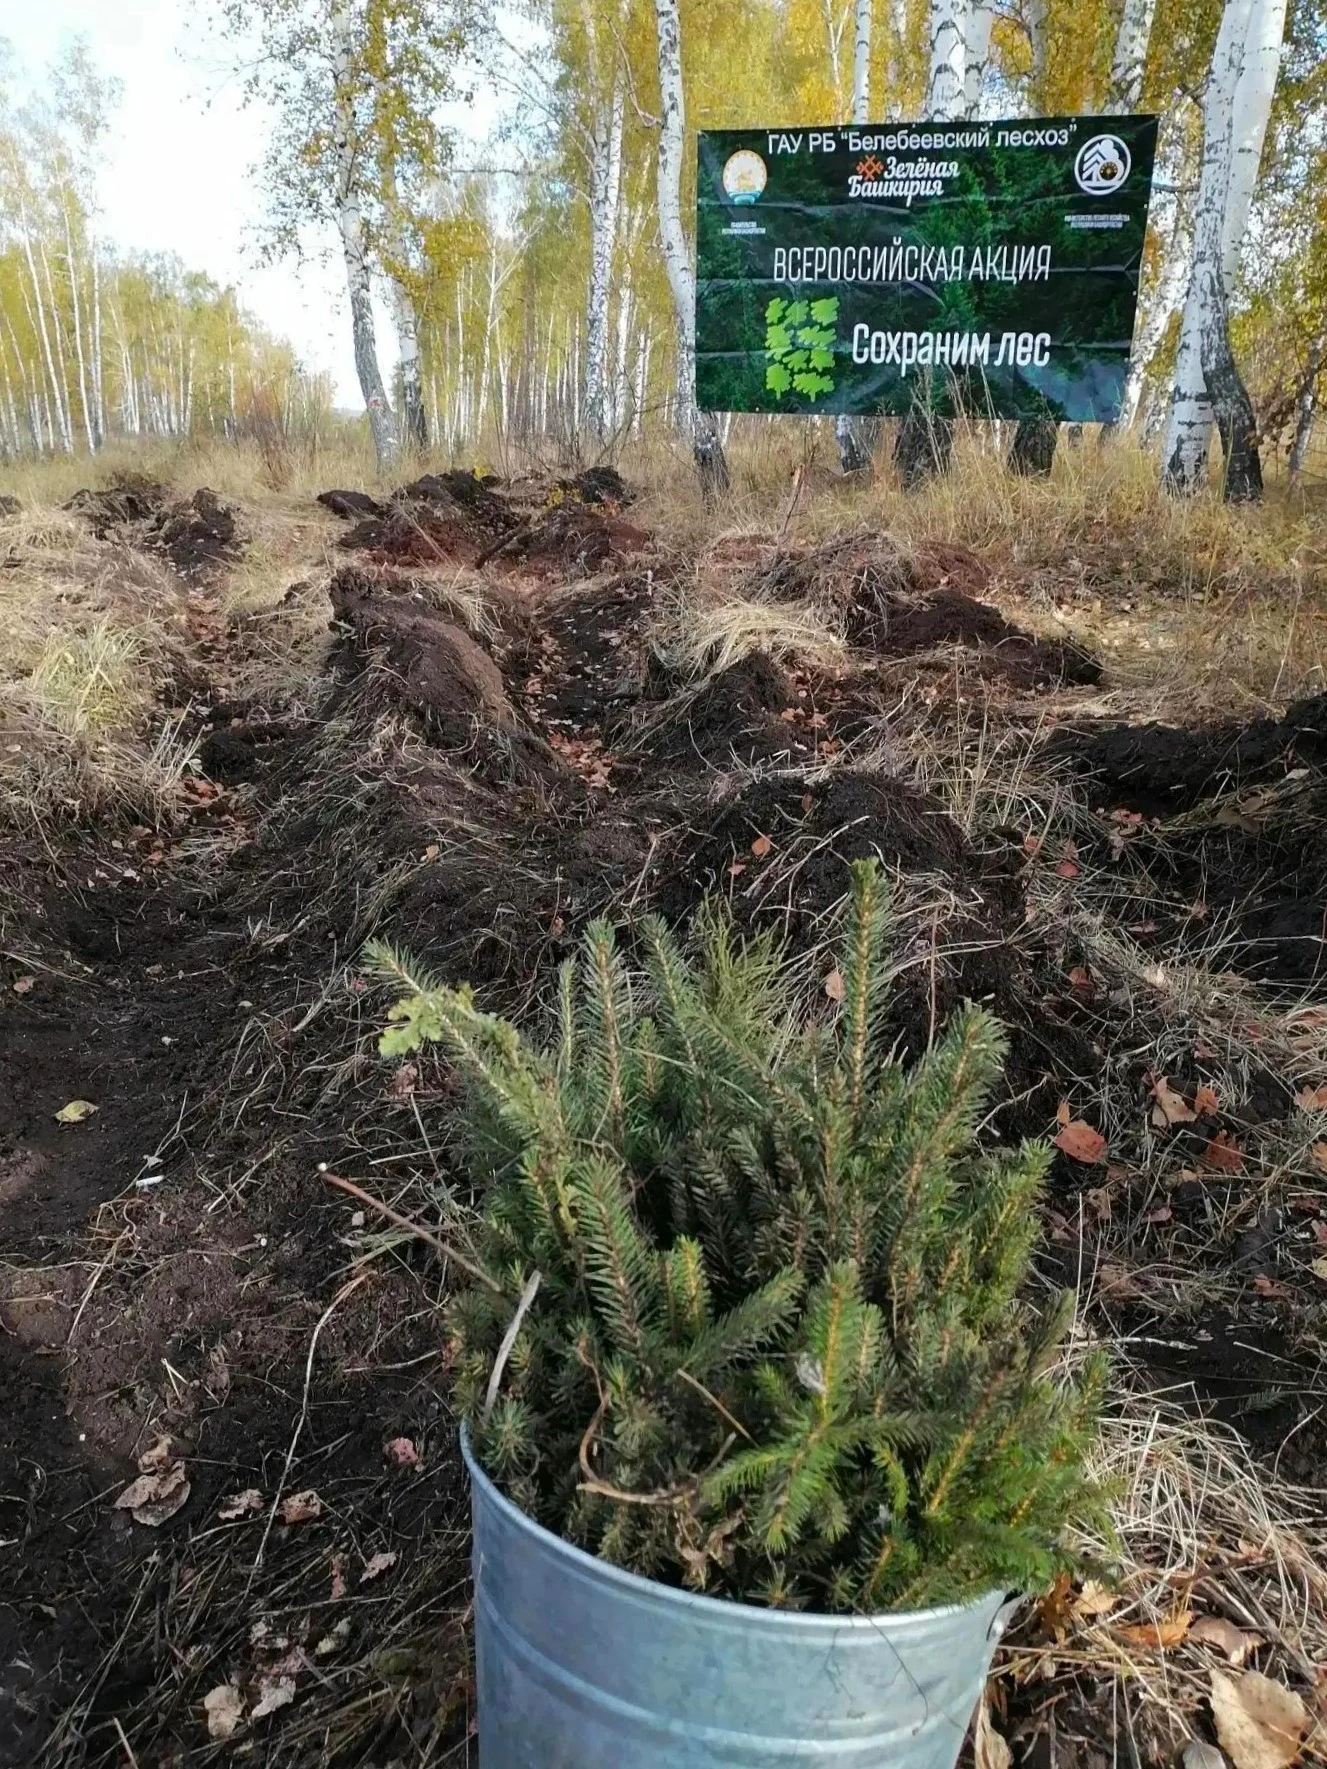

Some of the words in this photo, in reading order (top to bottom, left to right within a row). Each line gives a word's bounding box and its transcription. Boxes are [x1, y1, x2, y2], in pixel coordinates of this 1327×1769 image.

[768, 133, 803, 155] ГАУ
[808, 132, 837, 153] РБ
[883, 155, 961, 179] Зелёная
[847, 174, 945, 208] Башкирия
[773, 236, 965, 282] ВСЕРОССИЙСКАЯ
[968, 245, 1052, 285] АКЦИЯ
[852, 323, 991, 378] Сохраним
[993, 331, 1052, 367] лес
